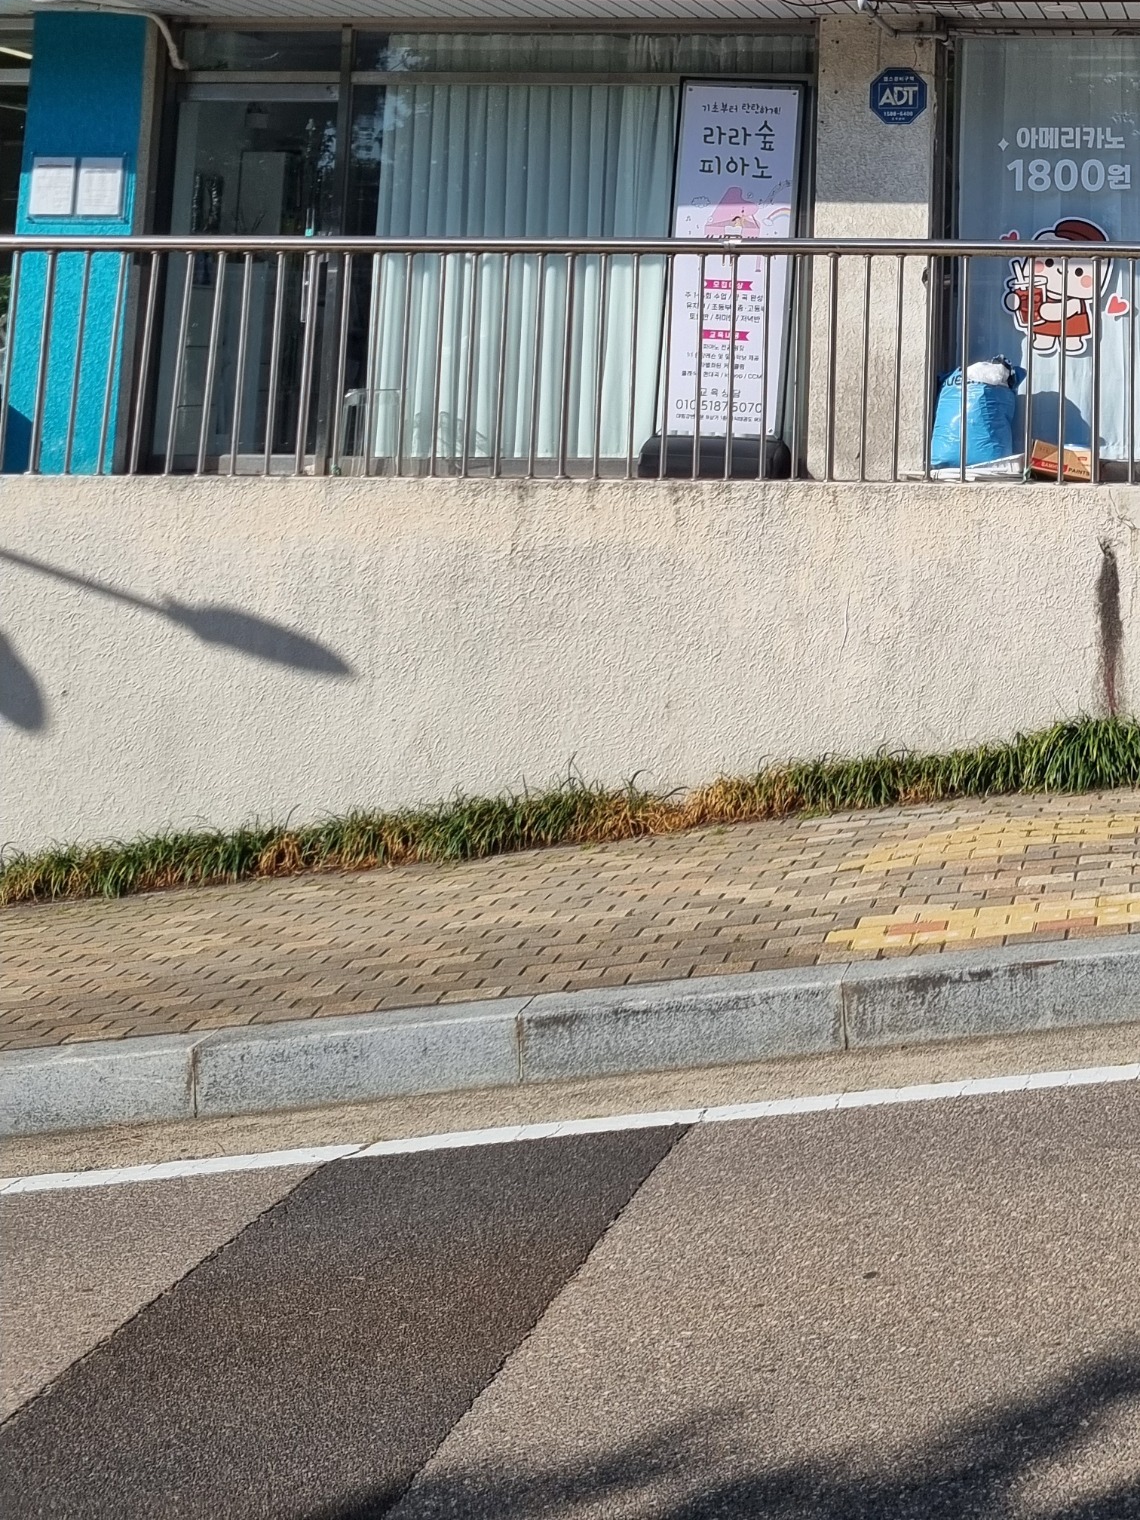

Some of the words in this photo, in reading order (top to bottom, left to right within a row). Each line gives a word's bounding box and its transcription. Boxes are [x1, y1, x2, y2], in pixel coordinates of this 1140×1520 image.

[702, 101, 738, 113] 기초부터
[878, 86, 919, 106] ADT
[703, 120, 776, 151] 라라숲
[1016, 127, 1126, 149] 아메리카노
[699, 155, 773, 179] 피아노
[1006, 158, 1131, 192] 1800원
